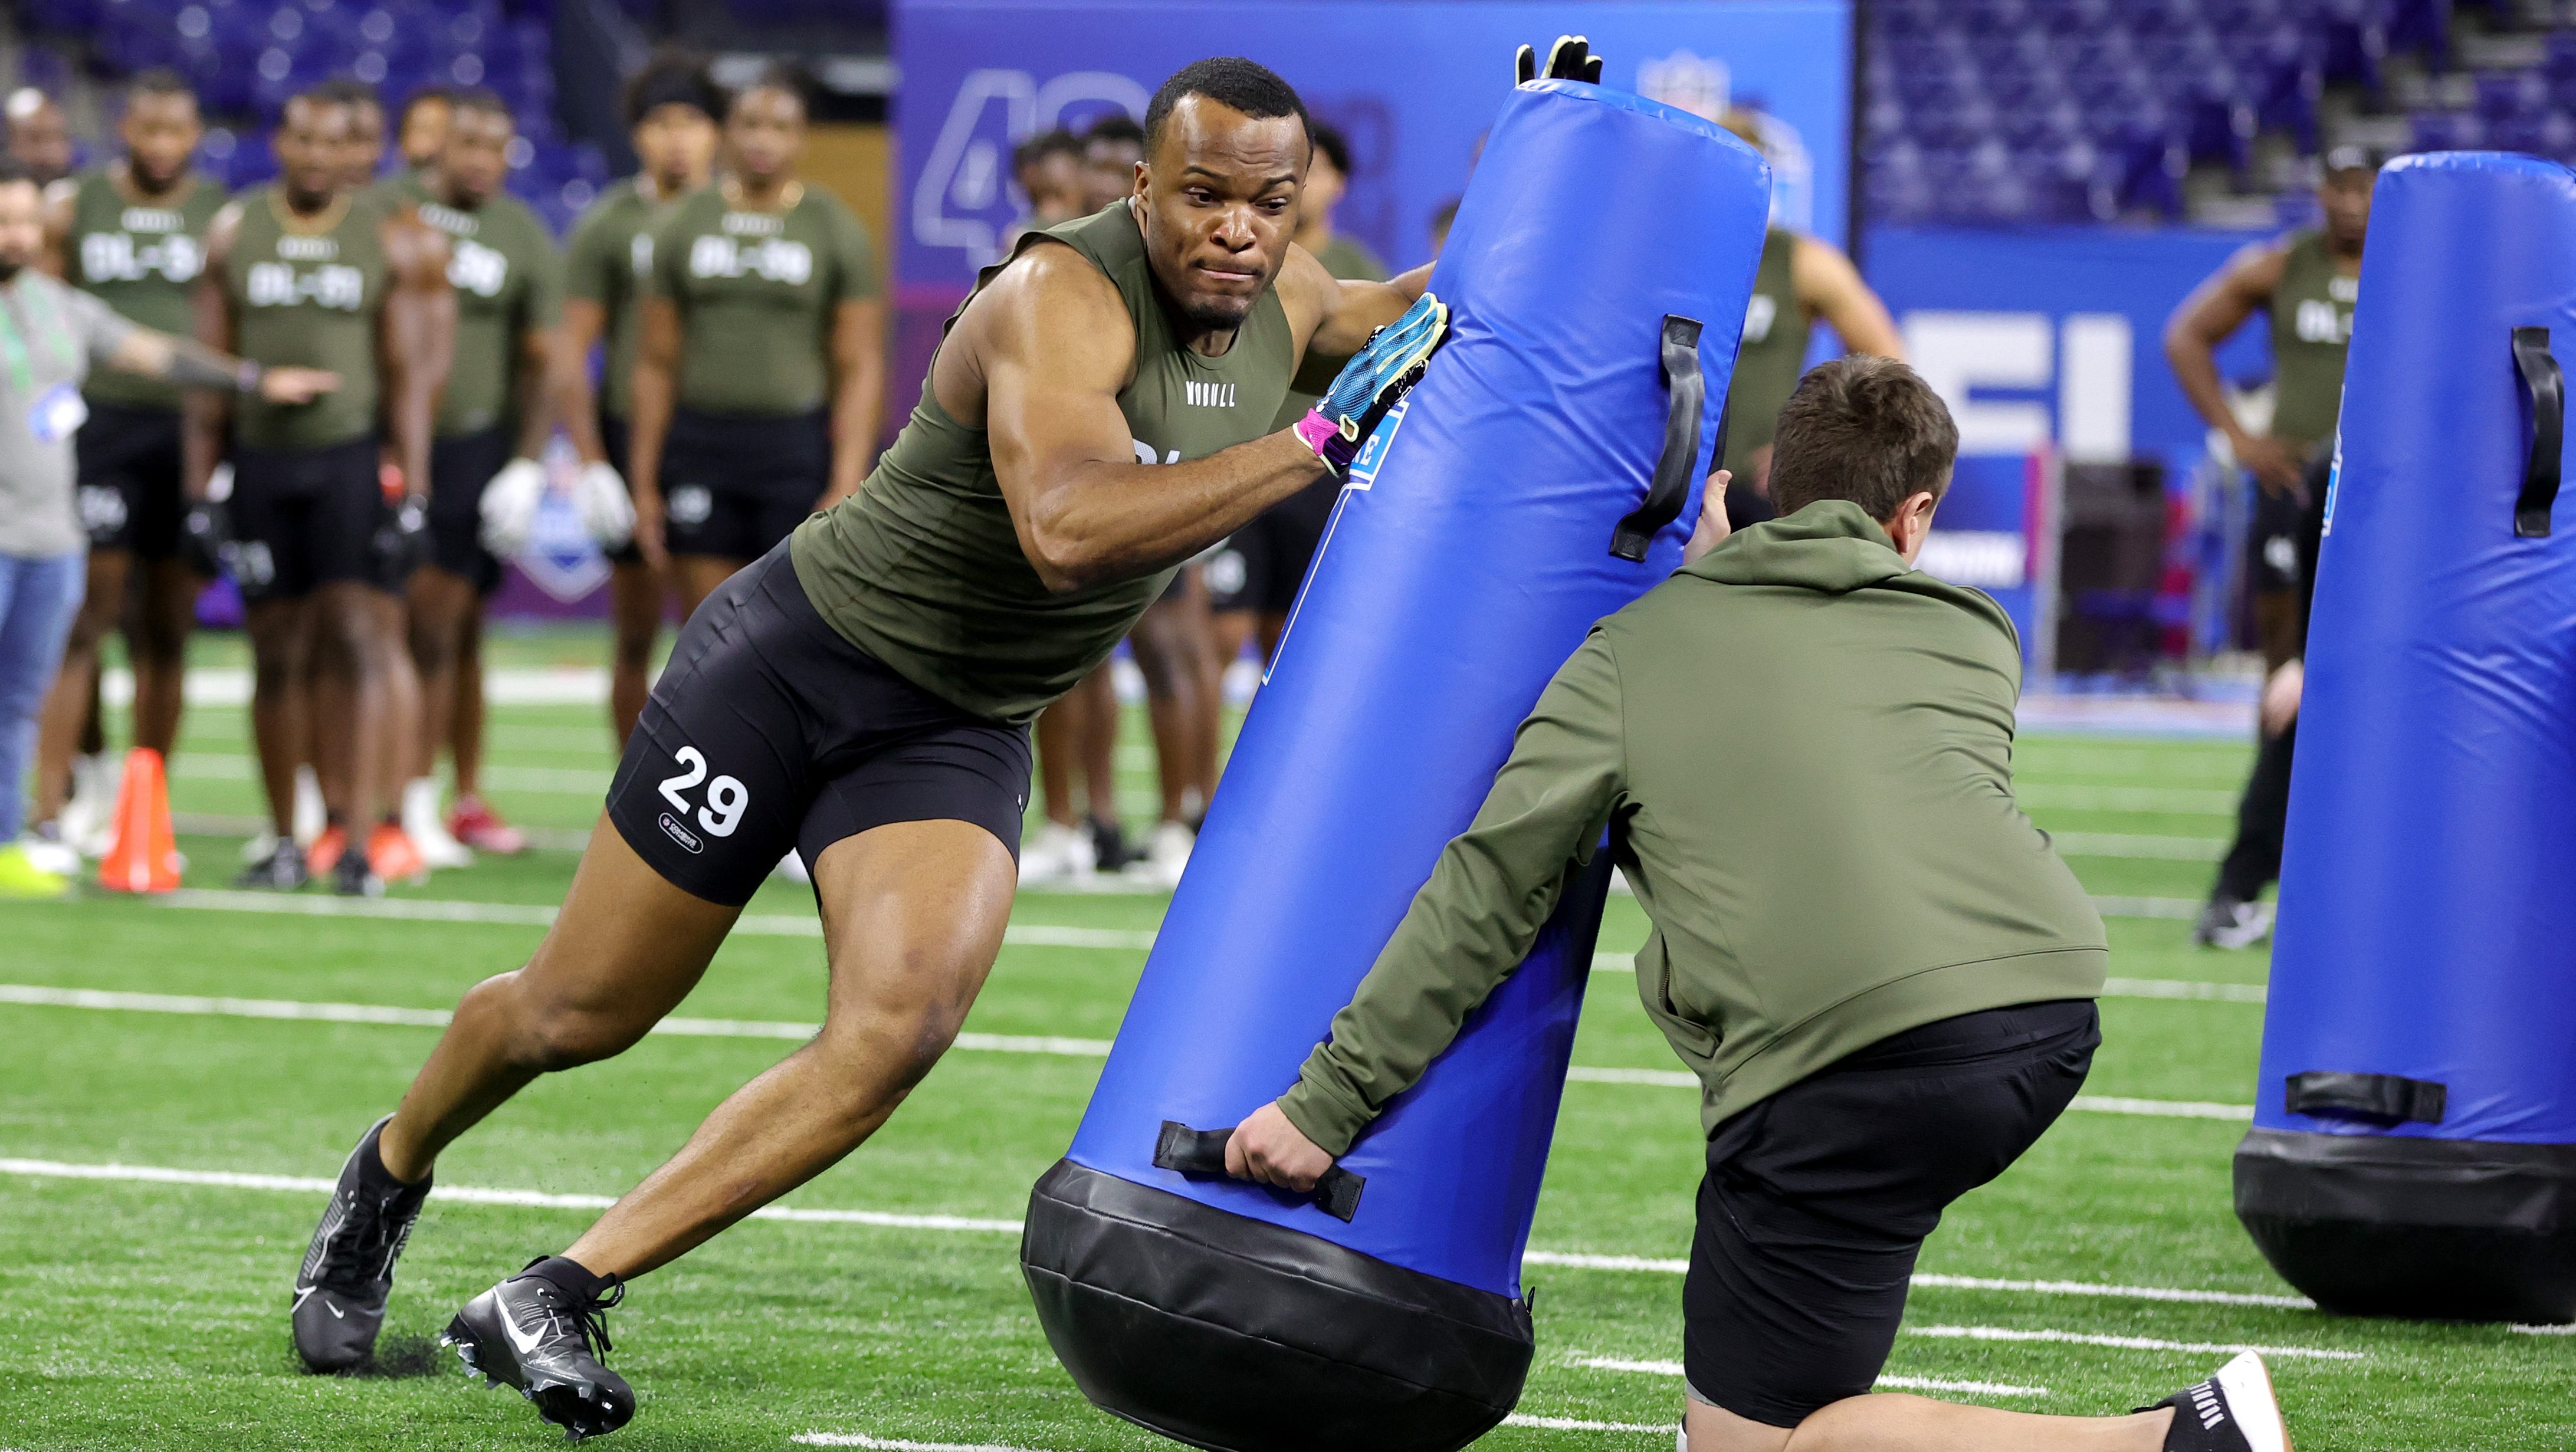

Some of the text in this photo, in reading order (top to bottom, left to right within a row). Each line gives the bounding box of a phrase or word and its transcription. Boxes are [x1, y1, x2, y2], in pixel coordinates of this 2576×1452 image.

[1186, 380, 1235, 408] NOBULL
[657, 745, 749, 837] 29
[2189, 1380, 2225, 1430] NOBULL
